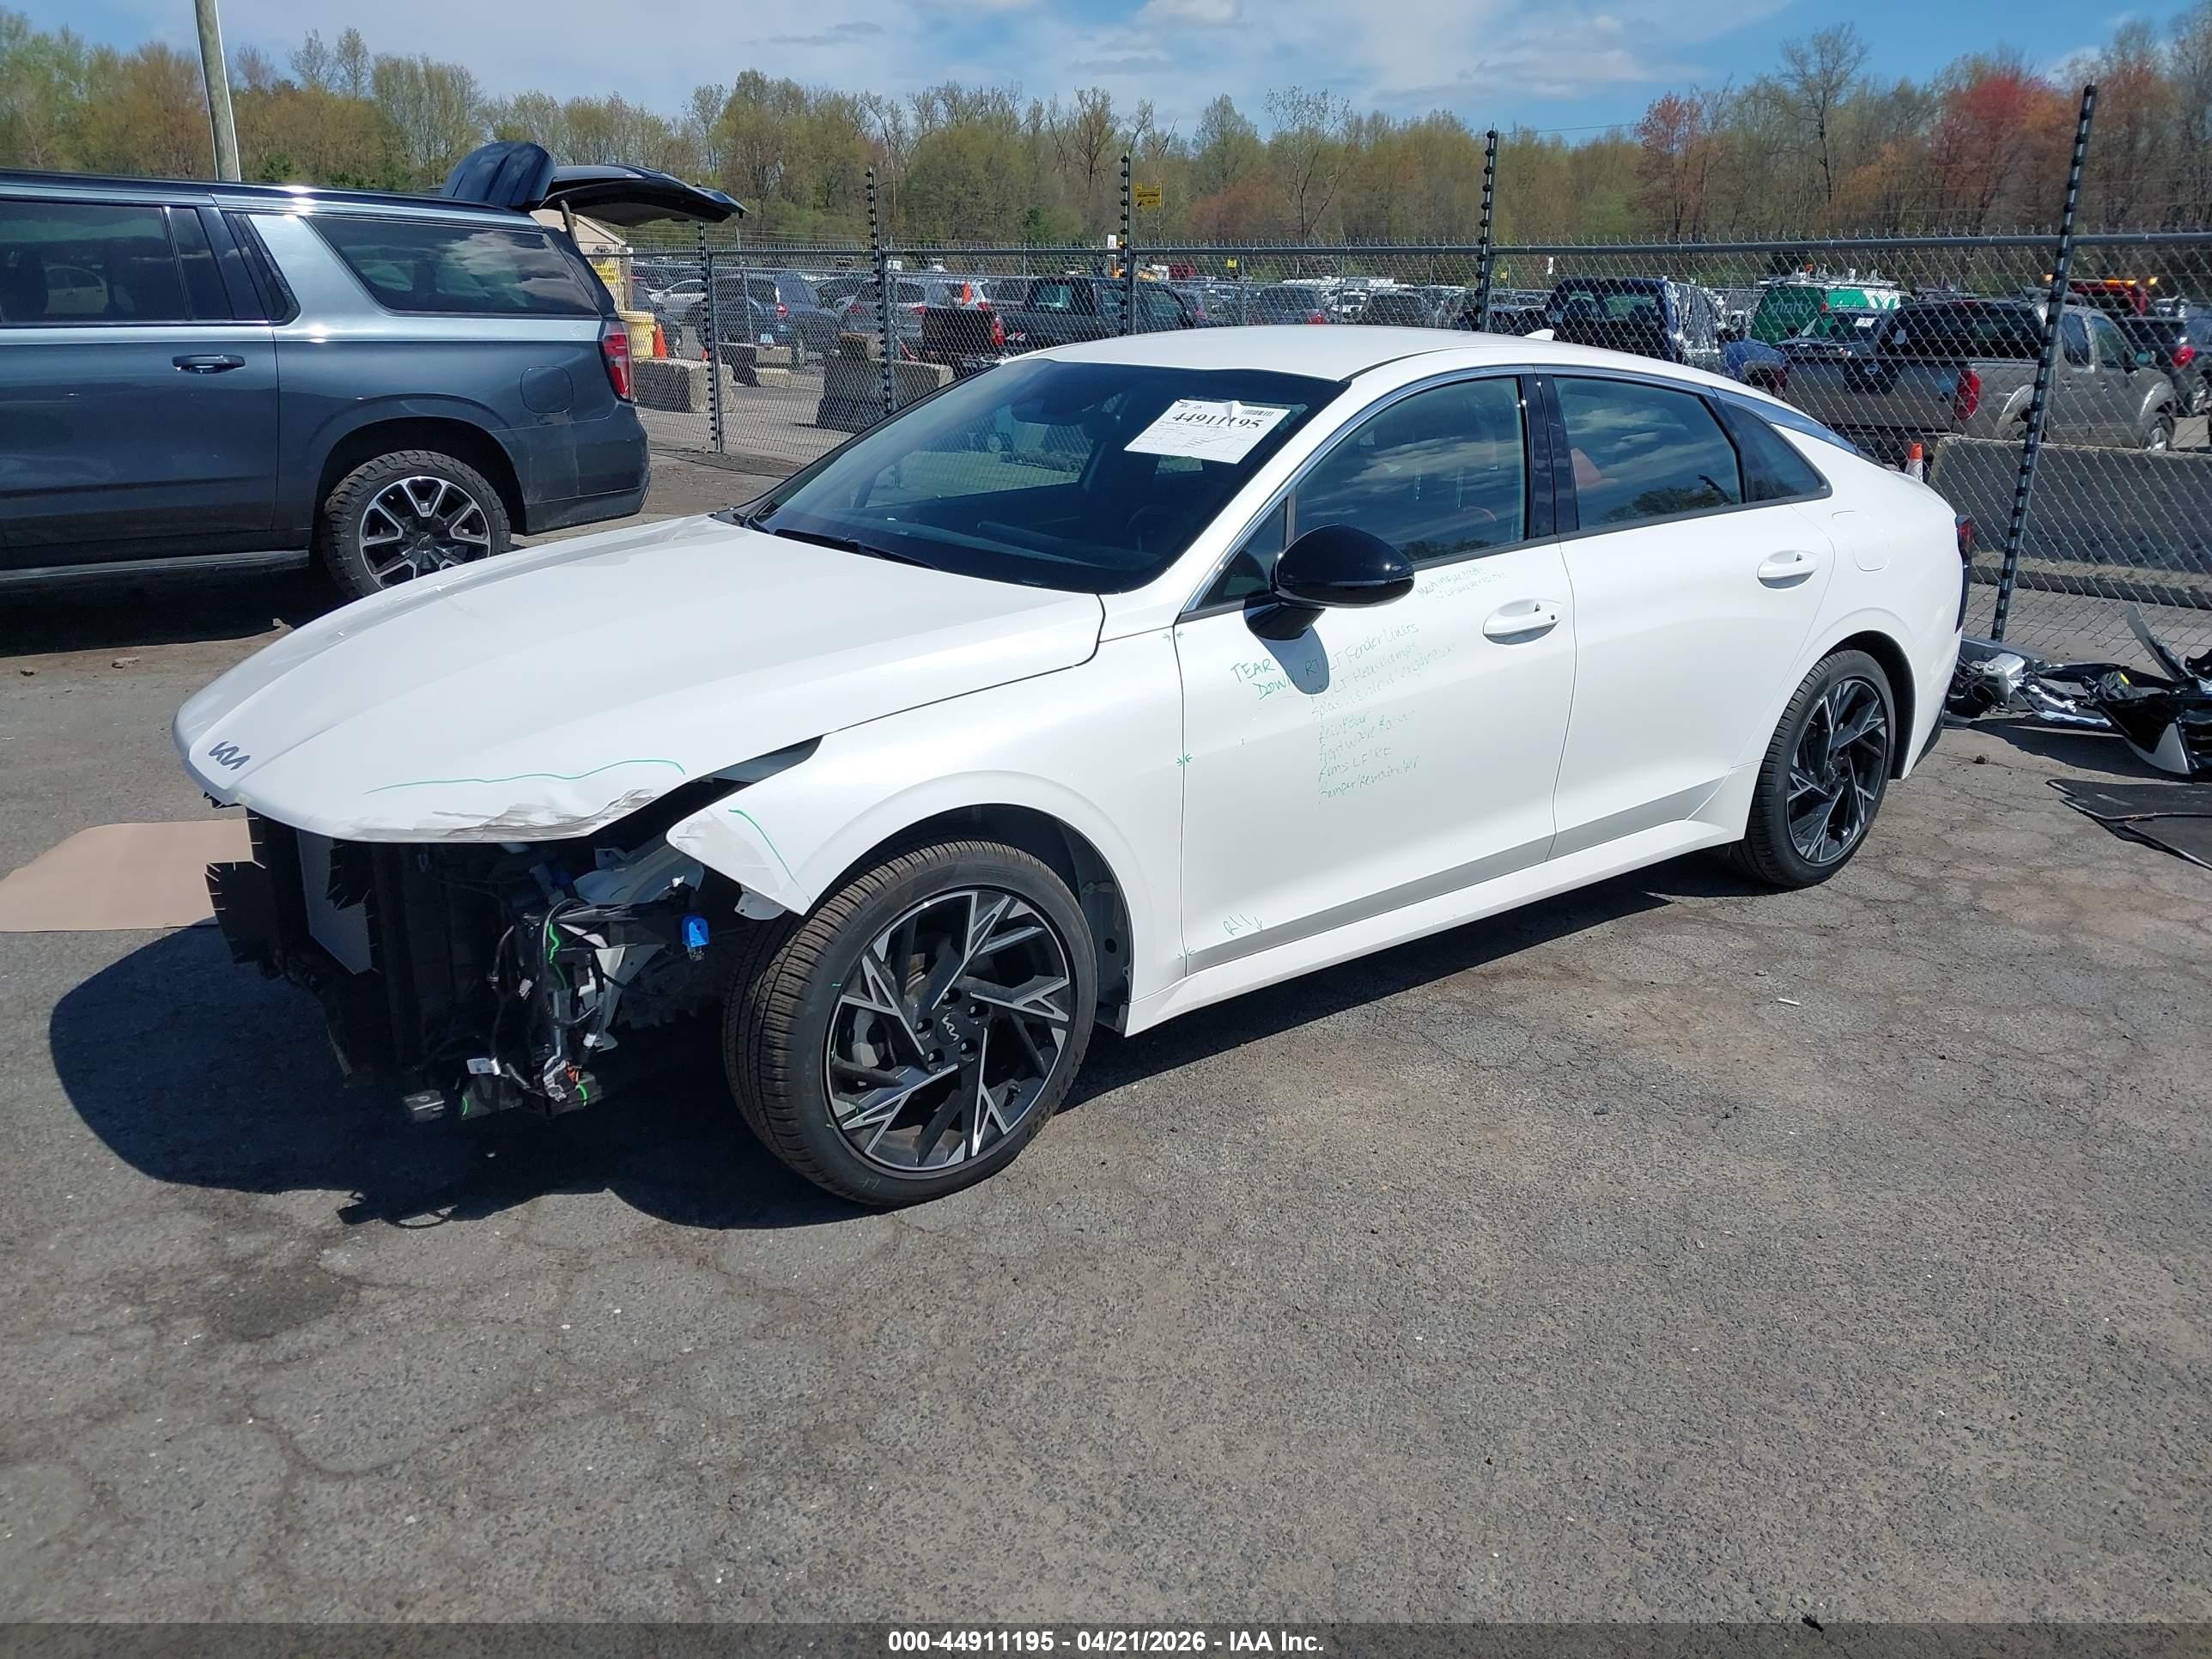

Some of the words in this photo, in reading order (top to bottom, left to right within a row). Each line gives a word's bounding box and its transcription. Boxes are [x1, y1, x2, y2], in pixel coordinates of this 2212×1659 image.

[1765, 300, 1813, 316] xfinity
[1171, 410, 1265, 429] 44911195
[1230, 659, 1277, 684] TEAR
[208, 740, 252, 771] KIA
